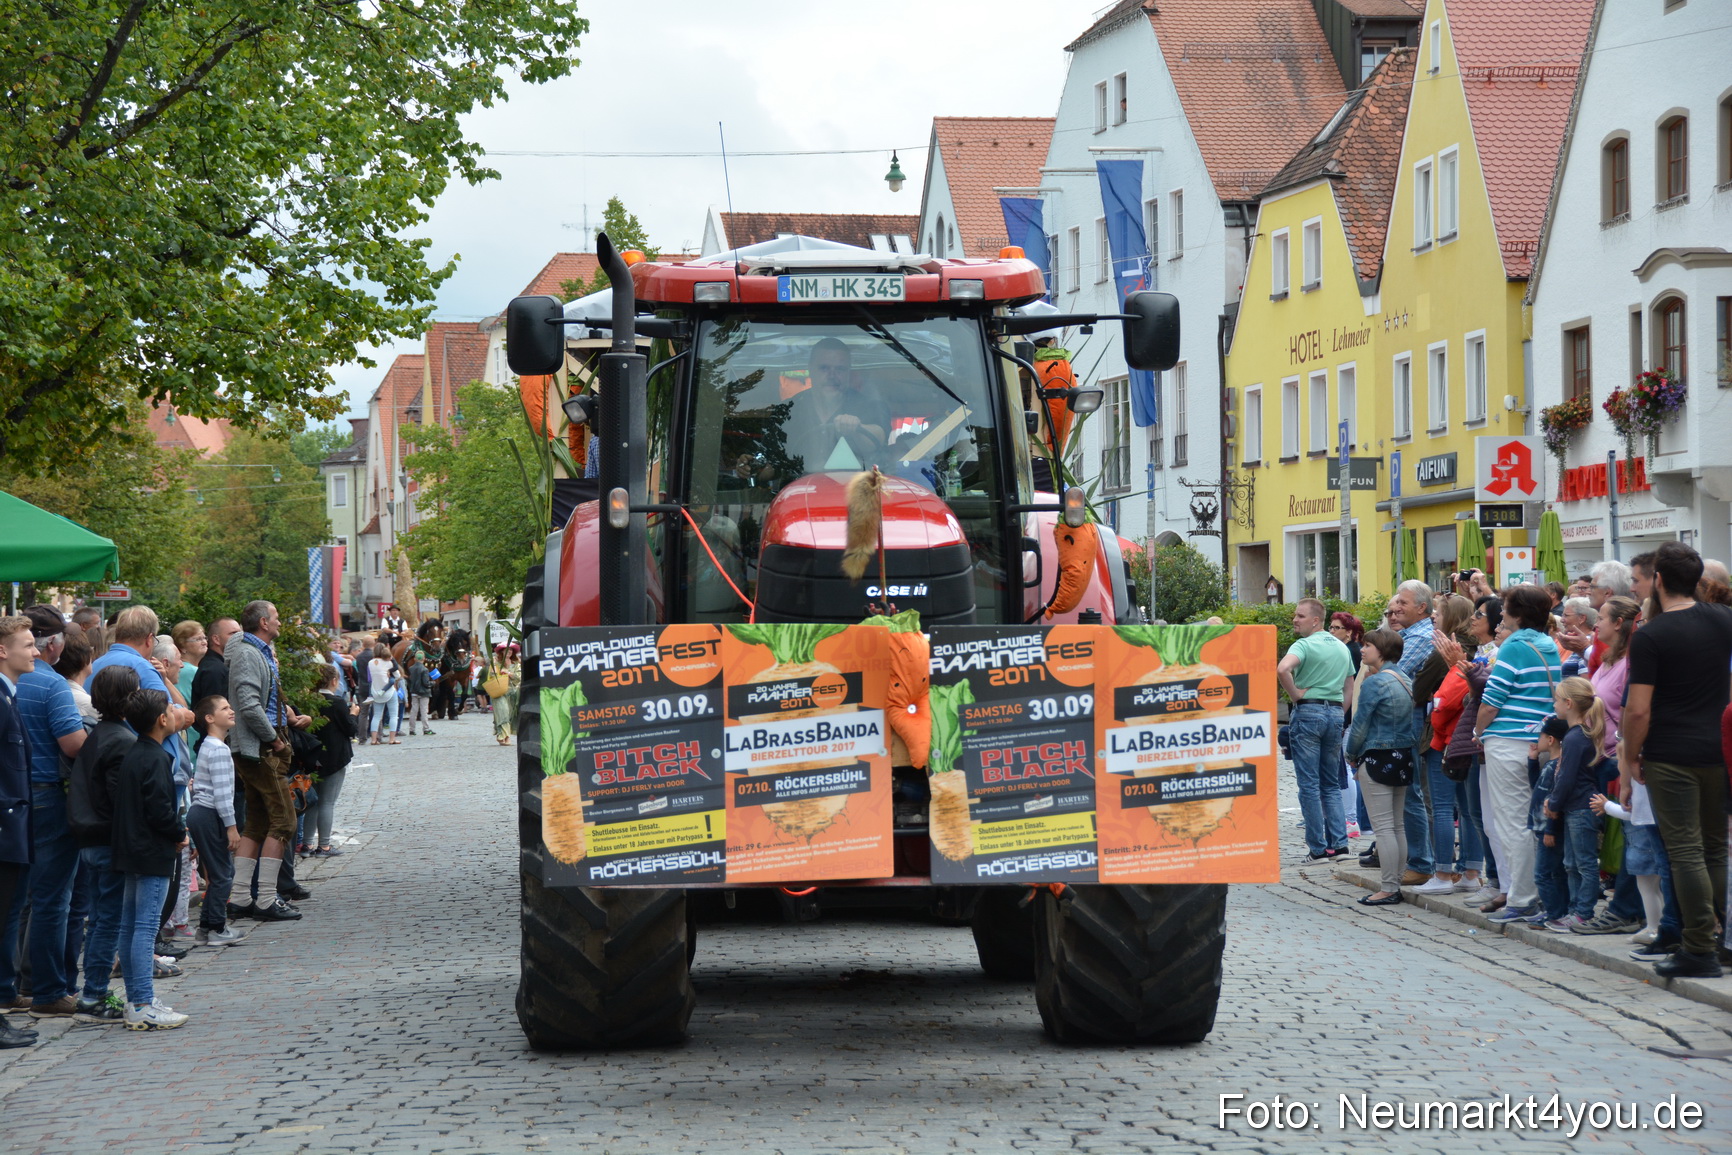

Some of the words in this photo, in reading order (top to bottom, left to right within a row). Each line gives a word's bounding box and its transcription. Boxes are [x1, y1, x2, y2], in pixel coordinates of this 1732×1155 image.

[791, 278, 818, 298] NM
[832, 278, 859, 298] HK
[864, 278, 902, 298] 345
[1290, 329, 1324, 365] HOTEL
[1332, 321, 1371, 352] Lehmeier
[1340, 427, 1348, 460] P
[1392, 458, 1399, 492] P
[1414, 458, 1449, 482] TAIFUN
[1330, 478, 1374, 486] TFUN
[1288, 493, 1336, 518] Restaurant
[1561, 528, 1574, 538] THAUS
[1575, 525, 1597, 536] APOTHEKE
[1623, 519, 1643, 531] RATHAUS
[1644, 517, 1669, 529] APOTHEKE
[544, 647, 566, 658] 20.
[567, 634, 655, 656] WORLDWIDE
[933, 646, 955, 656] 20.
[956, 634, 1042, 654] WORLDWIDE
[929, 641, 1095, 675] RAAHNERFES
[1057, 663, 1095, 672] RÖCKERSB
[601, 665, 660, 688] 2017
[988, 664, 1046, 686] 2017
[756, 685, 767, 693] 20
[768, 682, 798, 692] JAHRE
[1154, 684, 1184, 694] JAHRE
[577, 704, 637, 722] SAMSTAG
[641, 694, 714, 722] 30.09.
[780, 697, 811, 709] 2017
[965, 703, 1023, 720] SAMSTAG
[1028, 693, 1094, 721] 30.09
[1166, 699, 1197, 711] 2017
[579, 721, 600, 730] Einlass:
[601, 719, 616, 727] 19.30
[966, 719, 987, 728] Einlass:
[593, 740, 701, 770] PITCH
[751, 746, 828, 762] BIERZELTTOUR
[831, 741, 855, 753] 2017
[980, 740, 1086, 768] PITCH
[1137, 747, 1214, 763] BIERZELTTOUR
[1217, 744, 1241, 755] 2017
[594, 758, 712, 785] BLACK
[982, 757, 1095, 784] BLACK
[587, 788, 621, 797] SUPPORT:
[621, 785, 631, 793] DJ
[632, 783, 652, 792] FERLY
[666, 779, 685, 788] DOOR
[738, 781, 772, 795] 07.10.
[774, 769, 867, 791] RÖCKERSBÜHL
[776, 790, 790, 798] ALLE
[791, 788, 808, 796] INFOS
[808, 786, 820, 794] AUF
[821, 782, 858, 793] RAAHNER.DE
[973, 786, 1007, 796] SUPPORT:
[1017, 782, 1038, 791] FERLY
[1052, 778, 1071, 787] DOOR
[1124, 783, 1158, 796] 07.10.
[1161, 772, 1253, 793] RÖCKERSBÜHL
[1177, 790, 1193, 798] INFOS
[1207, 785, 1243, 795] RAAHNER.DE
[591, 827, 628, 837] Shuttlebusse
[638, 823, 660, 831] Einsatz.
[704, 814, 713, 839] !
[978, 825, 1014, 835] Shuttlebusse
[1024, 821, 1046, 830] Einsatz.
[593, 844, 612, 853] Einlass
[613, 842, 628, 850] unter
[637, 838, 655, 848] Jahren
[666, 835, 675, 843] mit
[676, 833, 704, 843] Partypass
[980, 841, 999, 850] Einlass
[1000, 840, 1013, 848] unter
[1023, 837, 1041, 845] Jahren
[1062, 832, 1089, 841] Partypass
[1104, 847, 1131, 855] Eintritt:
[590, 850, 726, 880] RÖCKERSBÜHL
[977, 850, 1098, 877] RÖCKERSBÜH
